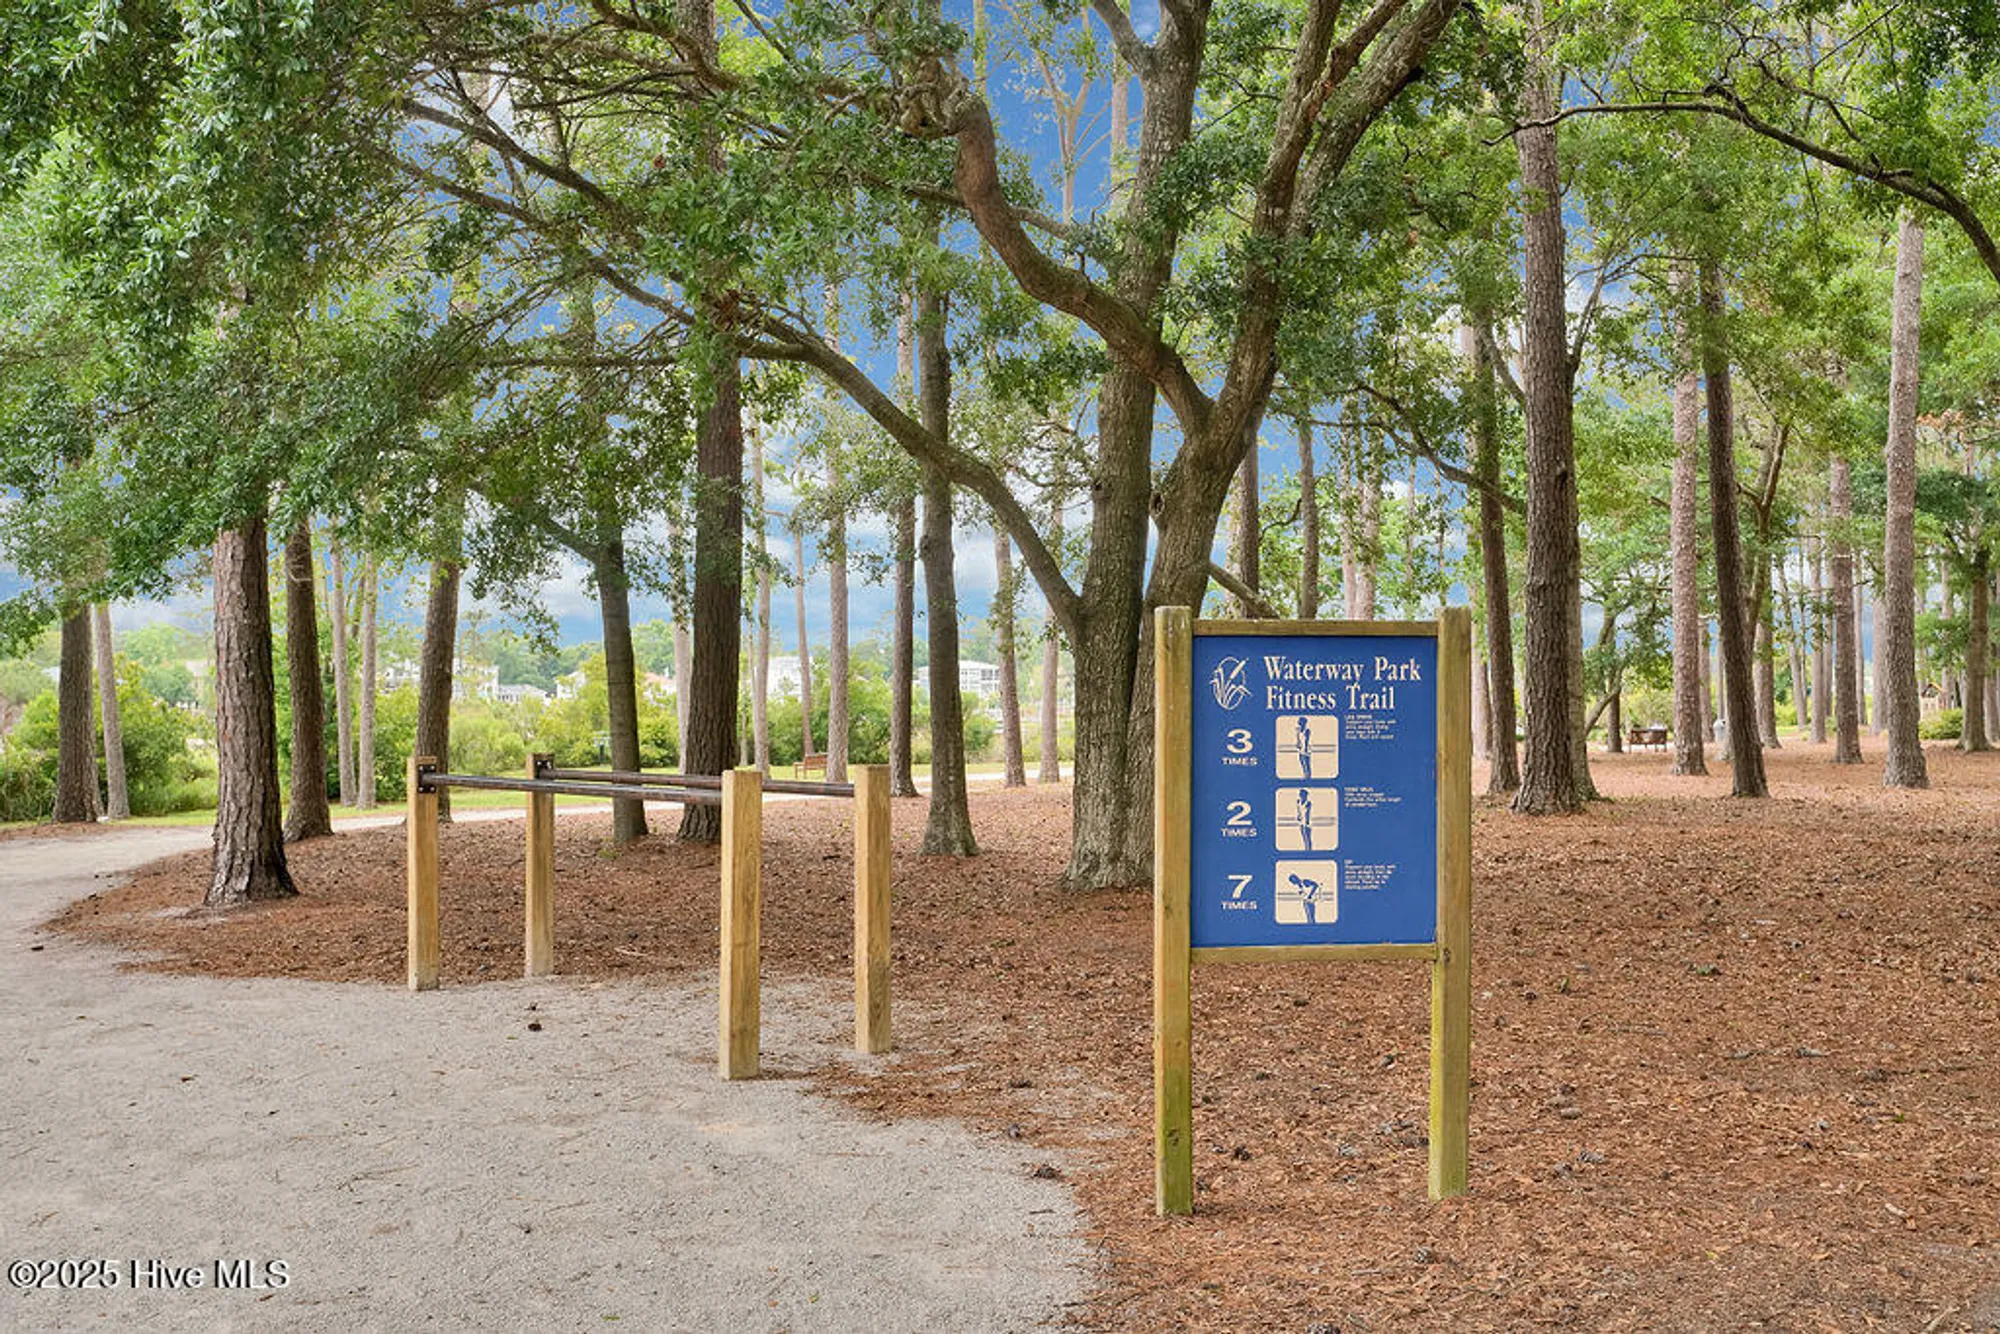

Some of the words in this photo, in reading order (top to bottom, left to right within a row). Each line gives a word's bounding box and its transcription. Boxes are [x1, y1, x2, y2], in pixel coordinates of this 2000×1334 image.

[1263, 656, 1365, 684] Waterway
[1374, 656, 1422, 681] Park
[1265, 685, 1337, 710] Fitness
[1345, 683, 1396, 710] Trail
[1226, 728, 1254, 754] 3
[1222, 757, 1258, 766] TIMES
[1226, 800, 1253, 826] 2
[1221, 828, 1258, 837] TIMES
[1227, 874, 1253, 899] 7
[1221, 901, 1258, 910] TIMES
